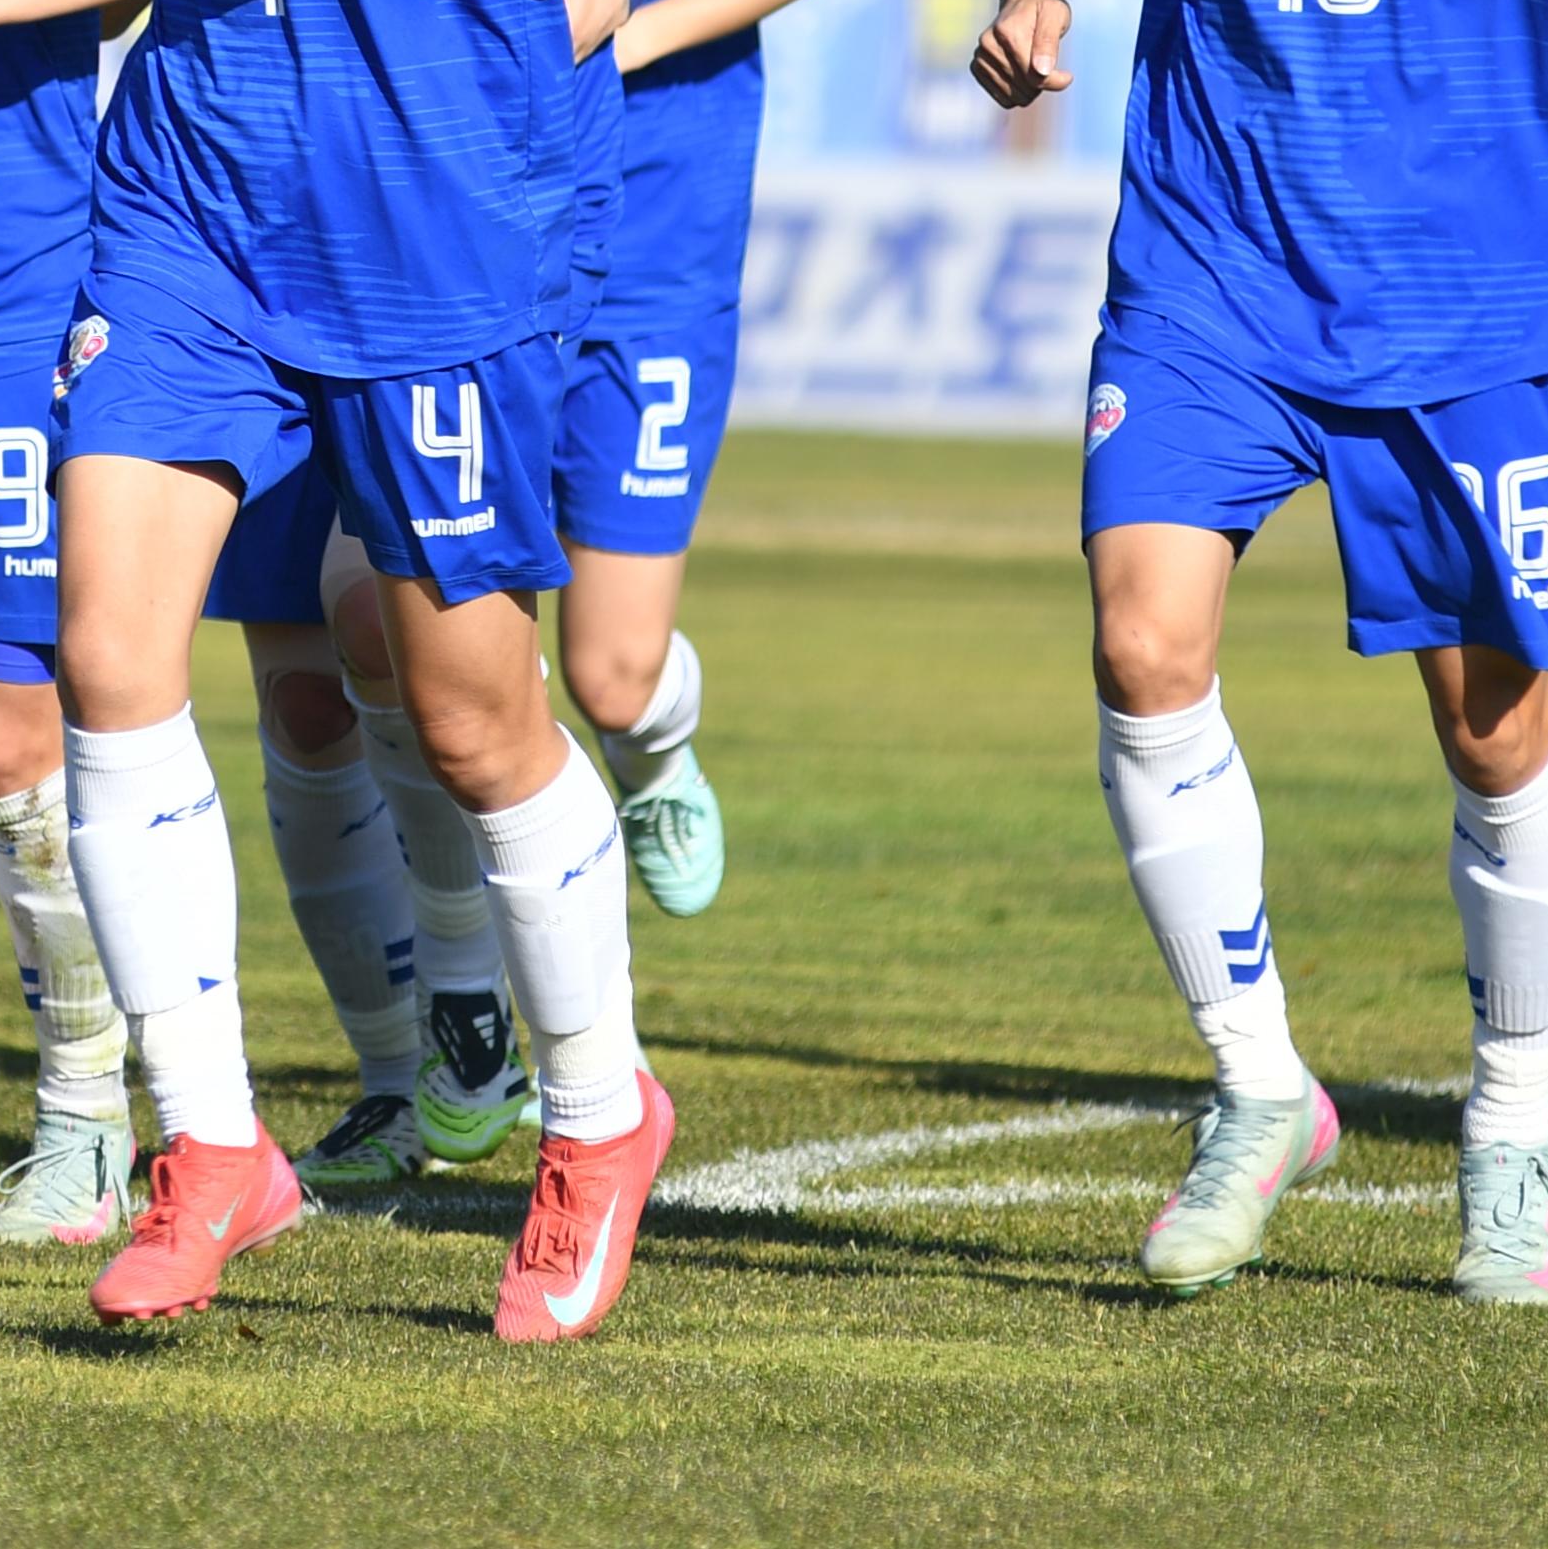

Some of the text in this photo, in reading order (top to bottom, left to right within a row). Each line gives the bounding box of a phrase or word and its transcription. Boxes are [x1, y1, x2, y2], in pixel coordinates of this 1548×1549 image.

[412, 382, 483, 503] 4
[636, 356, 692, 471] 2
[5, 554, 57, 577] hum
